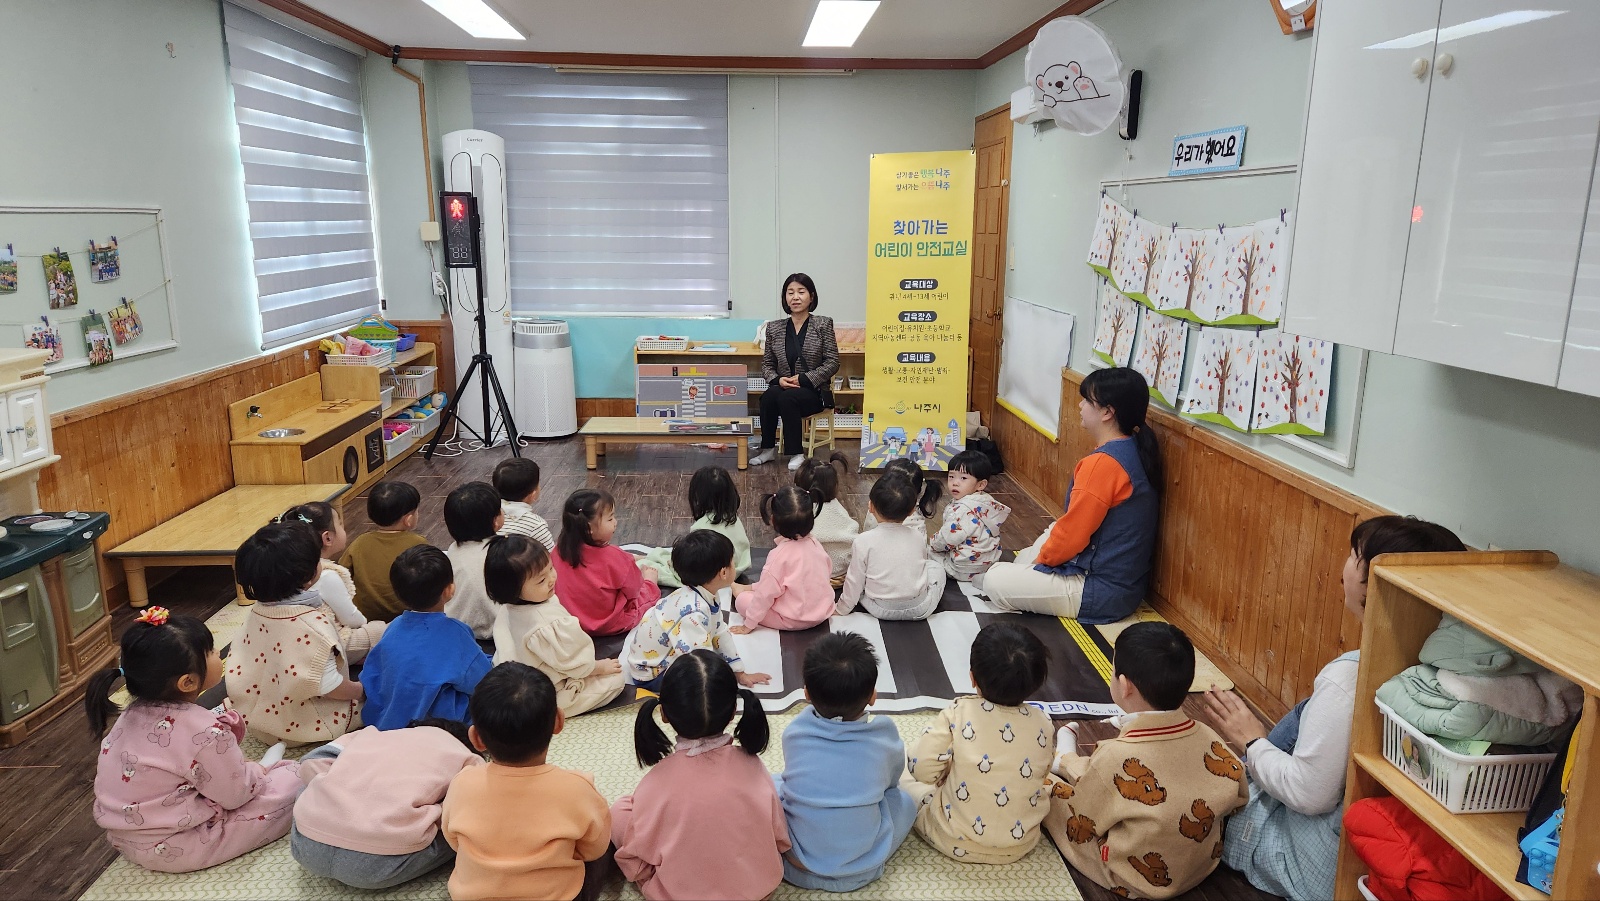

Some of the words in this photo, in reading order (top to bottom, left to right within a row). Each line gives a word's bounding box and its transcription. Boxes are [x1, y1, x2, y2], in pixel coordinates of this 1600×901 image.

[1175, 143, 1204, 167] 우리가
[894, 220, 948, 235] 찾아가는
[875, 242, 913, 257] 어린이
[917, 240, 967, 257] 안전교실
[904, 280, 933, 289] 교육대상
[903, 313, 932, 322] 교육장소
[902, 353, 931, 362] 교육내용
[914, 404, 941, 413] 나주시
[1048, 703, 1089, 712] EDN
